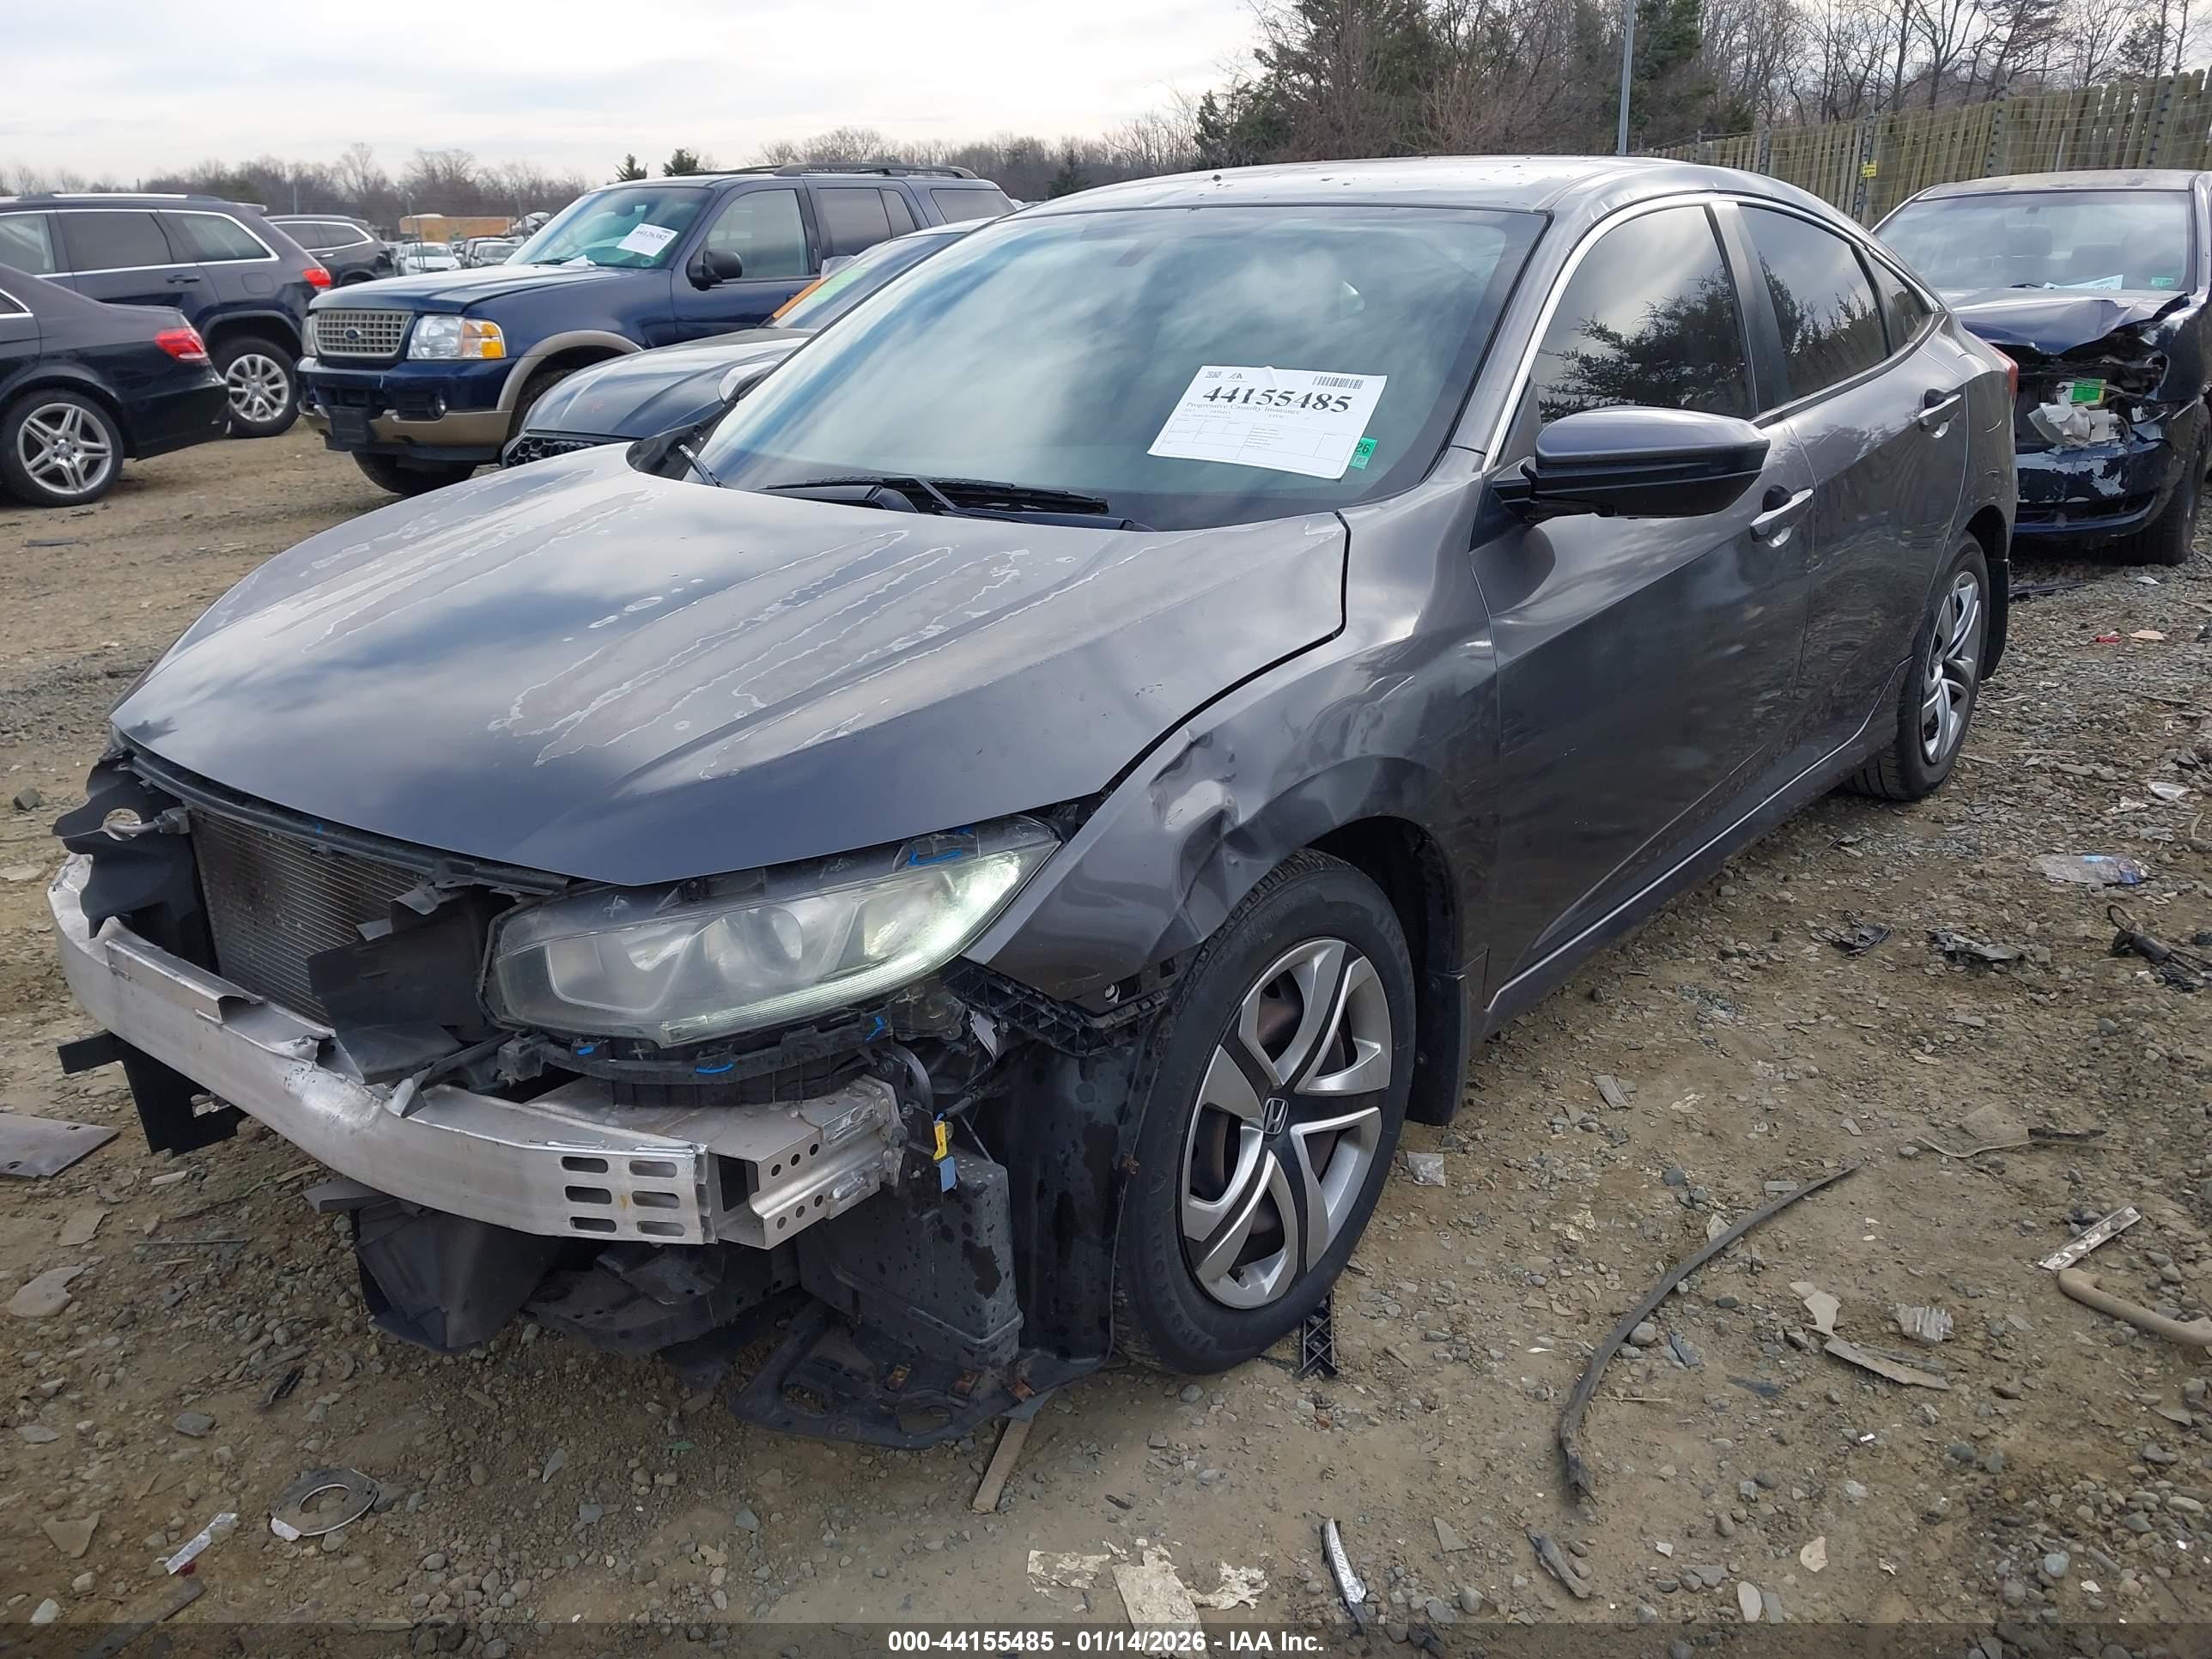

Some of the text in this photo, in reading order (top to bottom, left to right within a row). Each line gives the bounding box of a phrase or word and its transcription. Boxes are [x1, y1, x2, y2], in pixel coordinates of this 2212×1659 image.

[1202, 386, 1353, 413] 44155485
[1185, 401, 1302, 416] Progressive Casualty Insurance
[1354, 442, 1371, 454] 26
